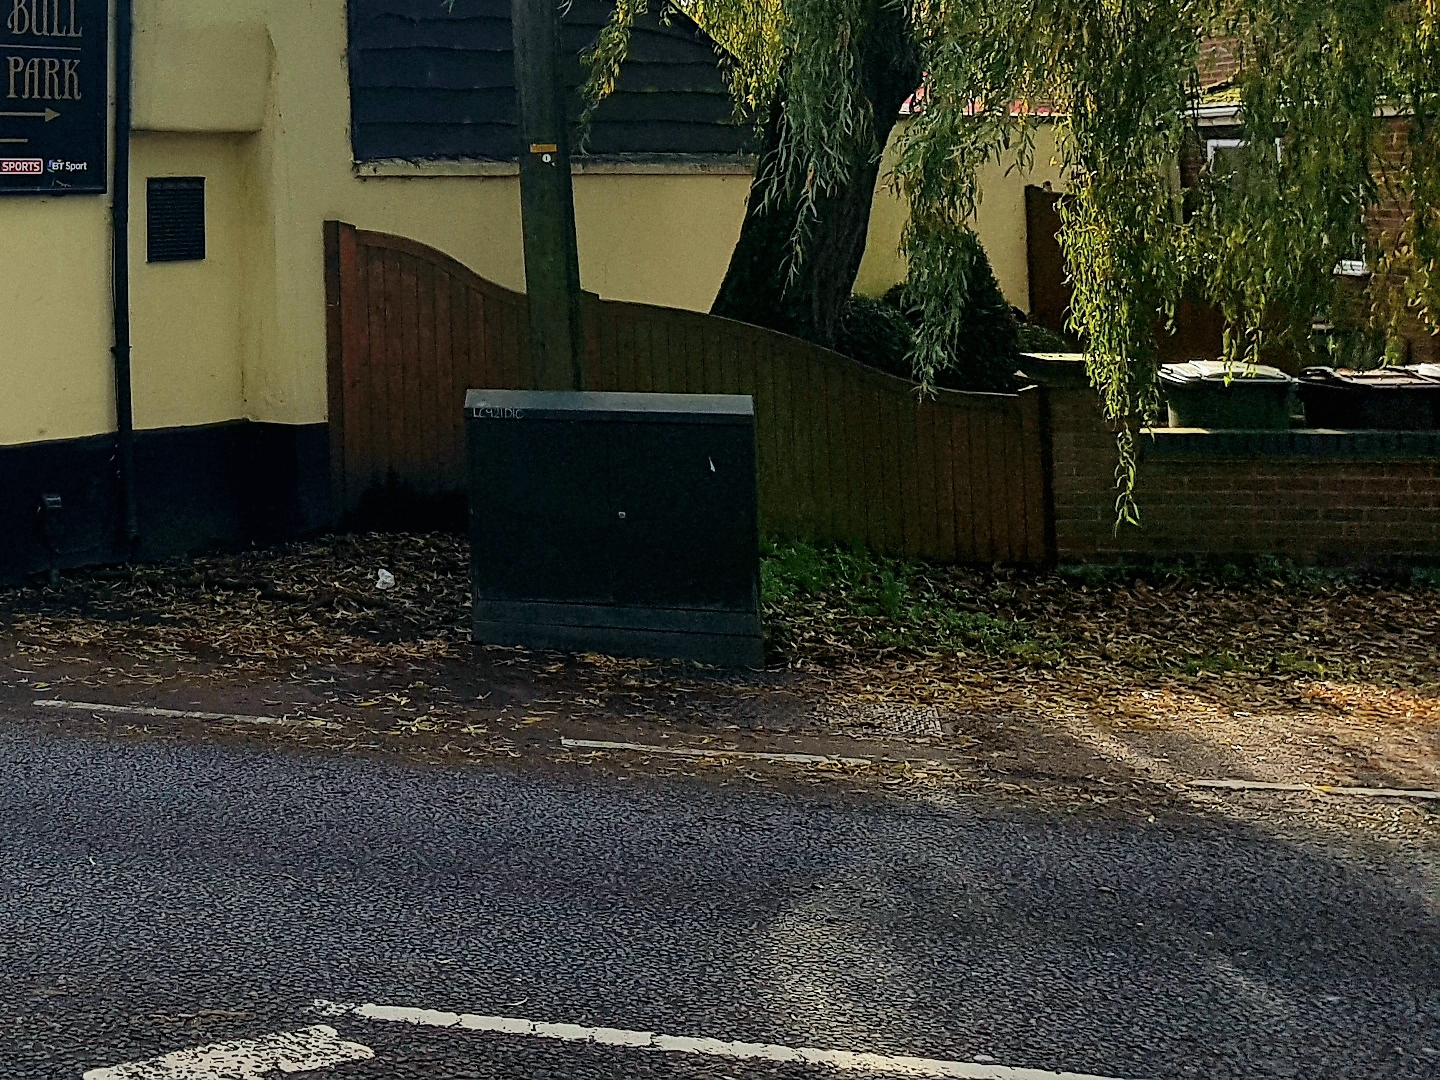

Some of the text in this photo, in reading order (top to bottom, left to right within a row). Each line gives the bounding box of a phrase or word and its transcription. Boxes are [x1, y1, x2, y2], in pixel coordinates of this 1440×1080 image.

[6, 56, 82, 101] PARK
[2, 161, 41, 172] SPORTS
[52, 161, 88, 172] BT Sport
